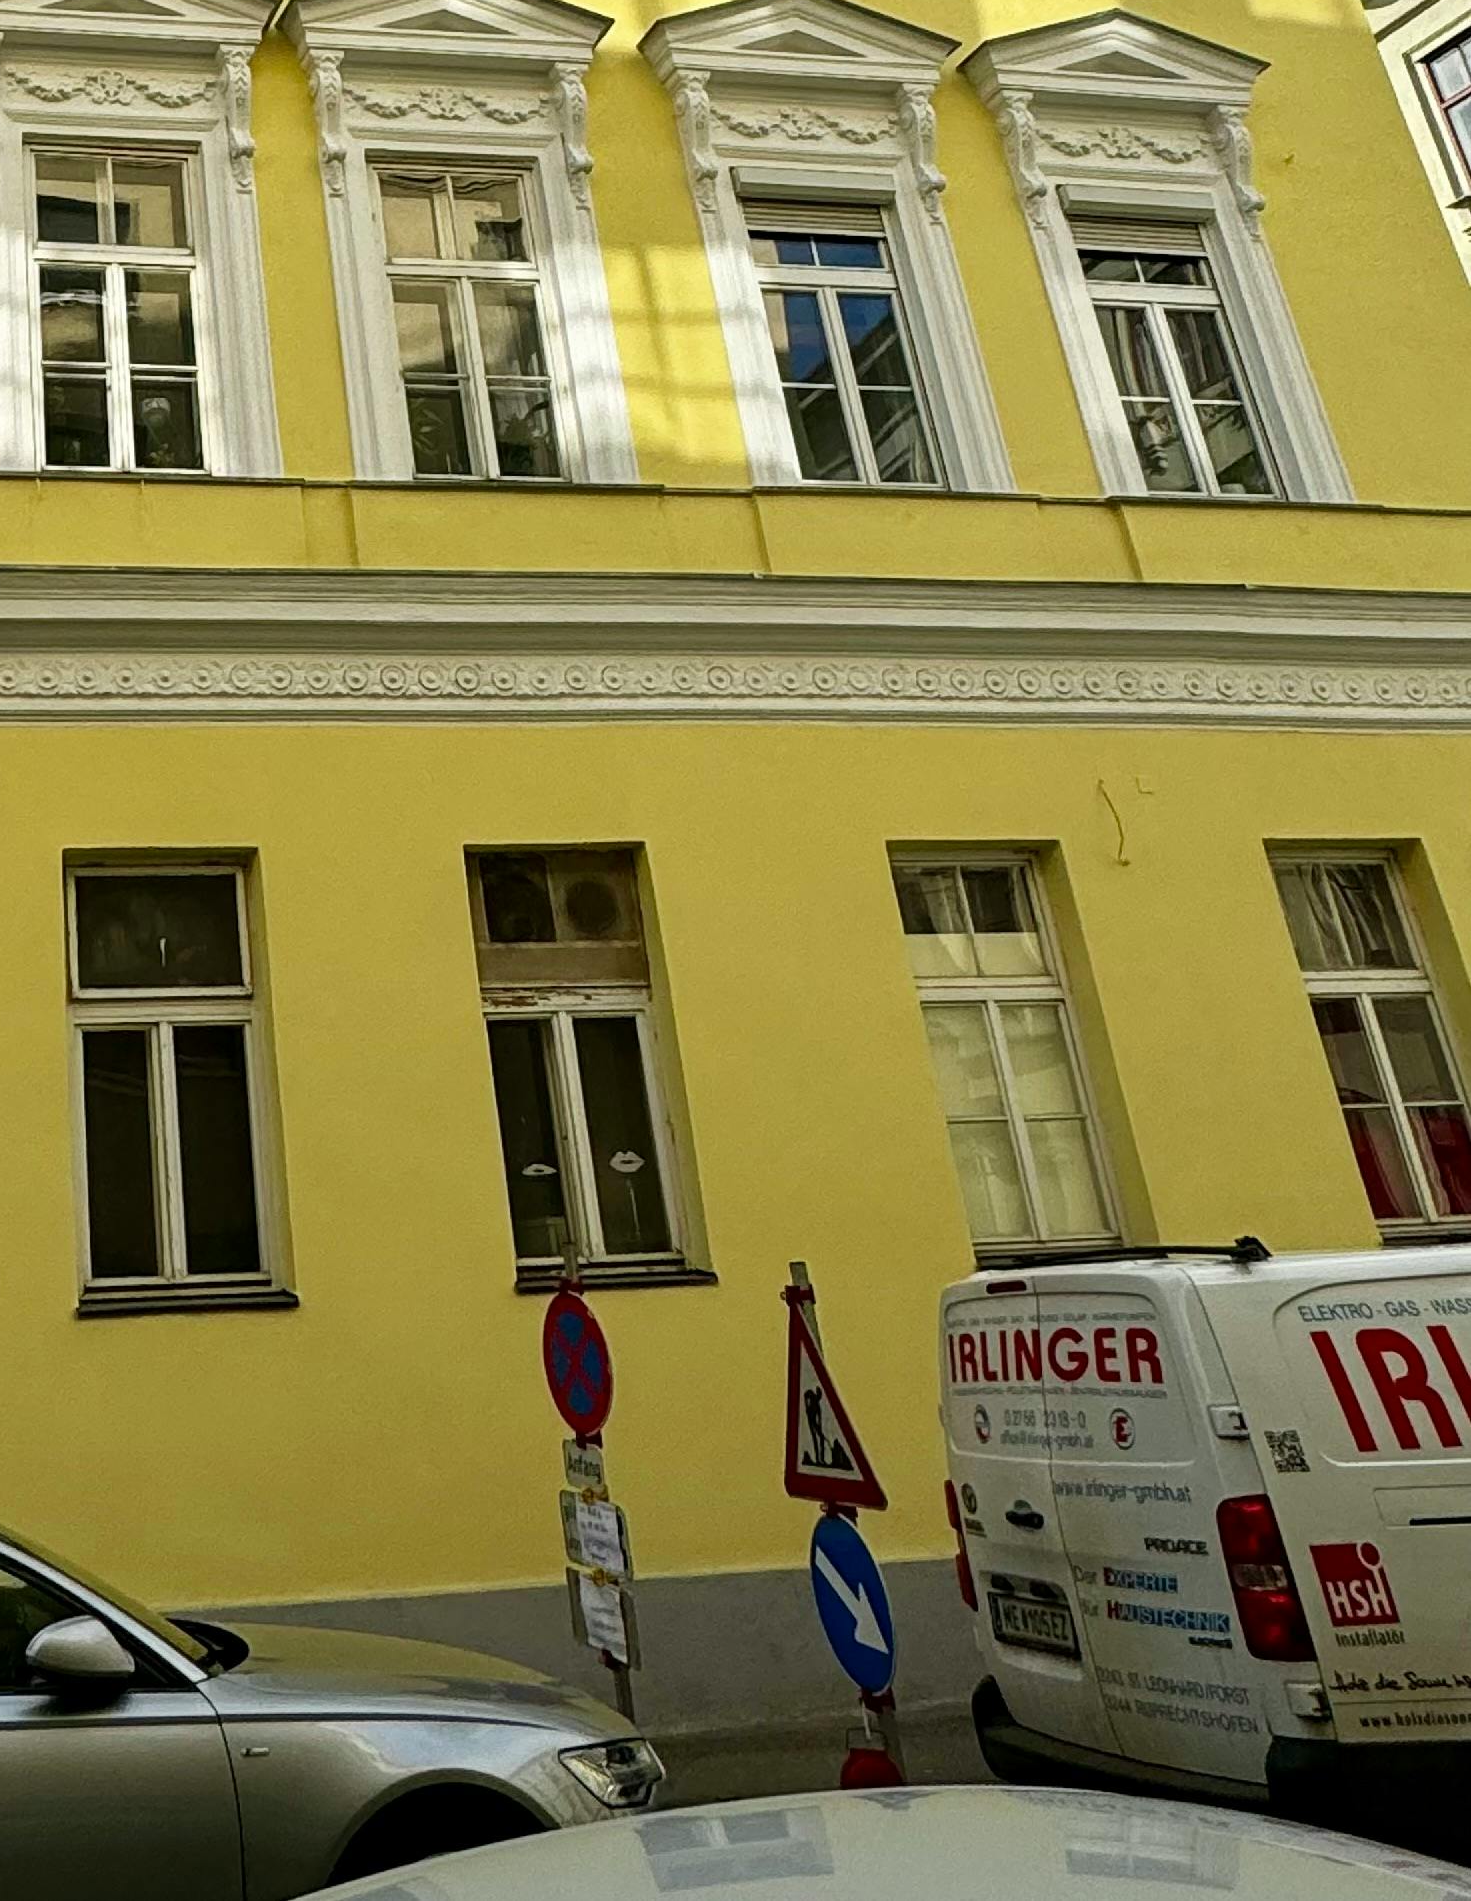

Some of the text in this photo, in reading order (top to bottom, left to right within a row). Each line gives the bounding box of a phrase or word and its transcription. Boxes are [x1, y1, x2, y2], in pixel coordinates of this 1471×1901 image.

[1298, 1302, 1374, 1322] ELEKTRO
[1384, 1300, 1420, 1317] GAS
[948, 1327, 1164, 1384] IRLINGER
[1143, 1537, 1209, 1556] PROACE
[1104, 1566, 1178, 1593] EXPERTE
[1106, 1600, 1231, 1633] HAUSTECHNIK
